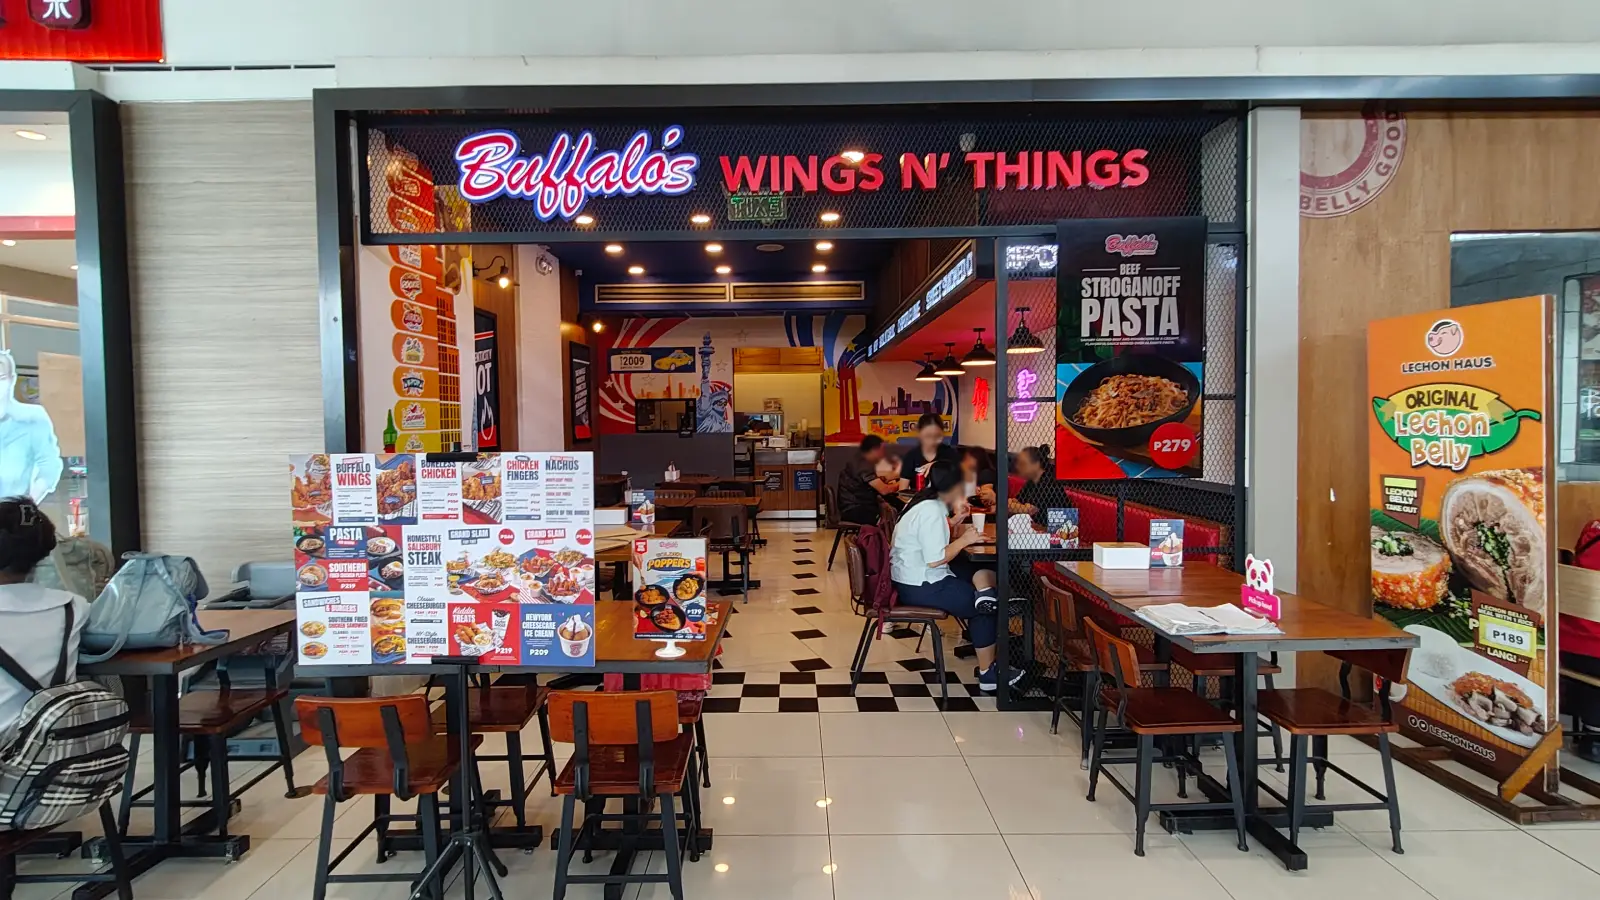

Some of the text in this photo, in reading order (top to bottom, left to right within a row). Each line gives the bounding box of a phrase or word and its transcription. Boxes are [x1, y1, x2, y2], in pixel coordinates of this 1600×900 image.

[456, 125, 699, 221] Buffalo's
[718, 149, 1150, 193] WINGS N' THINGS
[1300, 180, 1370, 210] BELLY
[1120, 264, 1141, 276] BEEF
[1081, 276, 1180, 298] STROGANOFF
[1080, 296, 1180, 337] PASTA
[623, 356, 644, 366] 2009
[1402, 357, 1493, 373] LECHON HAUS
[1405, 390, 1479, 410] ORIGINAL
[1394, 410, 1490, 437] Lechon
[1411, 439, 1472, 471] Belly
[336, 463, 370, 473] BUFFALO
[507, 460, 539, 470] CHICKEN
[545, 460, 579, 470] NACHOS
[421, 468, 456, 478] CHICKEN
[507, 471, 539, 480] FINGERS
[337, 473, 371, 486] WINGS
[1385, 487, 1417, 498] LECHON
[1389, 495, 1414, 505] BELLY
[329, 528, 363, 540] PASTA
[471, 529, 488, 538] SLAM
[547, 529, 564, 538] SLAM
[408, 552, 442, 565] STEAK
[329, 563, 366, 572] SOUTHERN
[647, 559, 691, 571] POPPERS
[452, 606, 475, 614] Kiddie
[1481, 604, 1528, 619] LECHON BELLY
[452, 614, 476, 624] TREATS
[1495, 612, 1512, 621] WITH
[522, 622, 556, 630] CHEESECAKE
[1493, 630, 1523, 645] P189
[1487, 648, 1516, 662] LANG!
[1429, 725, 1495, 760] LECHONHAUS
